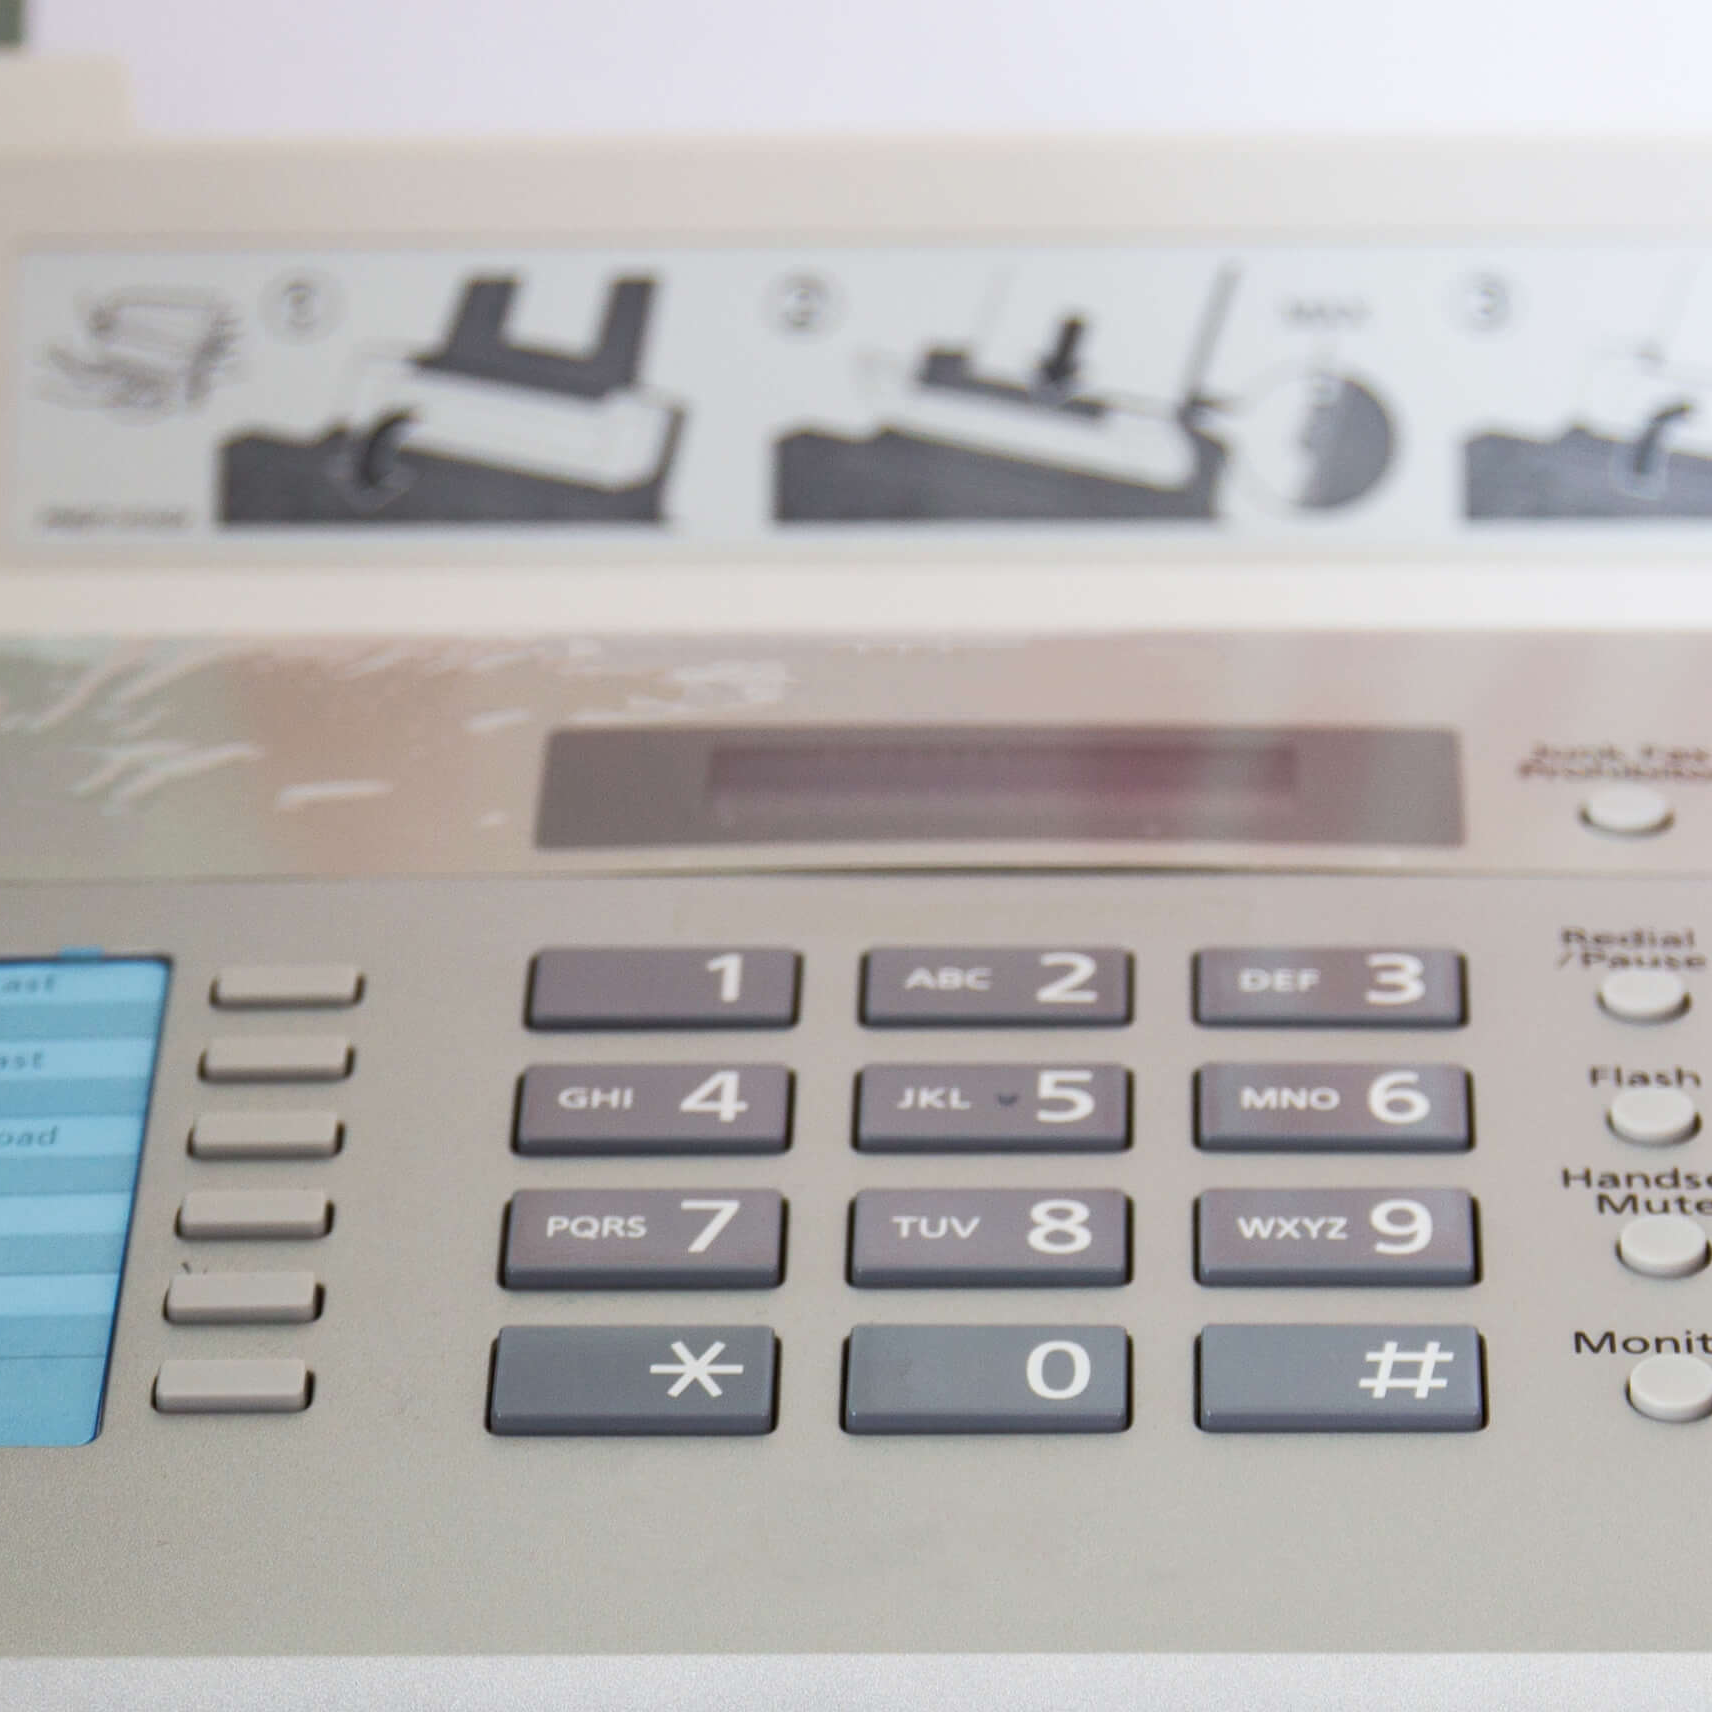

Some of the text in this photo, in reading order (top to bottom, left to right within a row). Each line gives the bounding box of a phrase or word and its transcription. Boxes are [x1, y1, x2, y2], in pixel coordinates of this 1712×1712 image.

[1556, 949, 1708, 972] /Pause
[1558, 926, 1697, 949] Redial
[707, 953, 743, 1002] 1
[905, 952, 1097, 1003] ABC 2
[1238, 953, 1426, 1004] DEF 3
[557, 1070, 748, 1122] GHI 4
[897, 1070, 1095, 1123] JKL 5
[1240, 1071, 1431, 1124] MNO 6
[1588, 1066, 1702, 1088] Flash
[546, 1199, 740, 1253] PQRS 7
[892, 1199, 1092, 1254] TUV 8
[1237, 1199, 1433, 1255] WXYZ 9
[1026, 1340, 1091, 1400] 0
[1358, 1340, 1455, 1399] #
